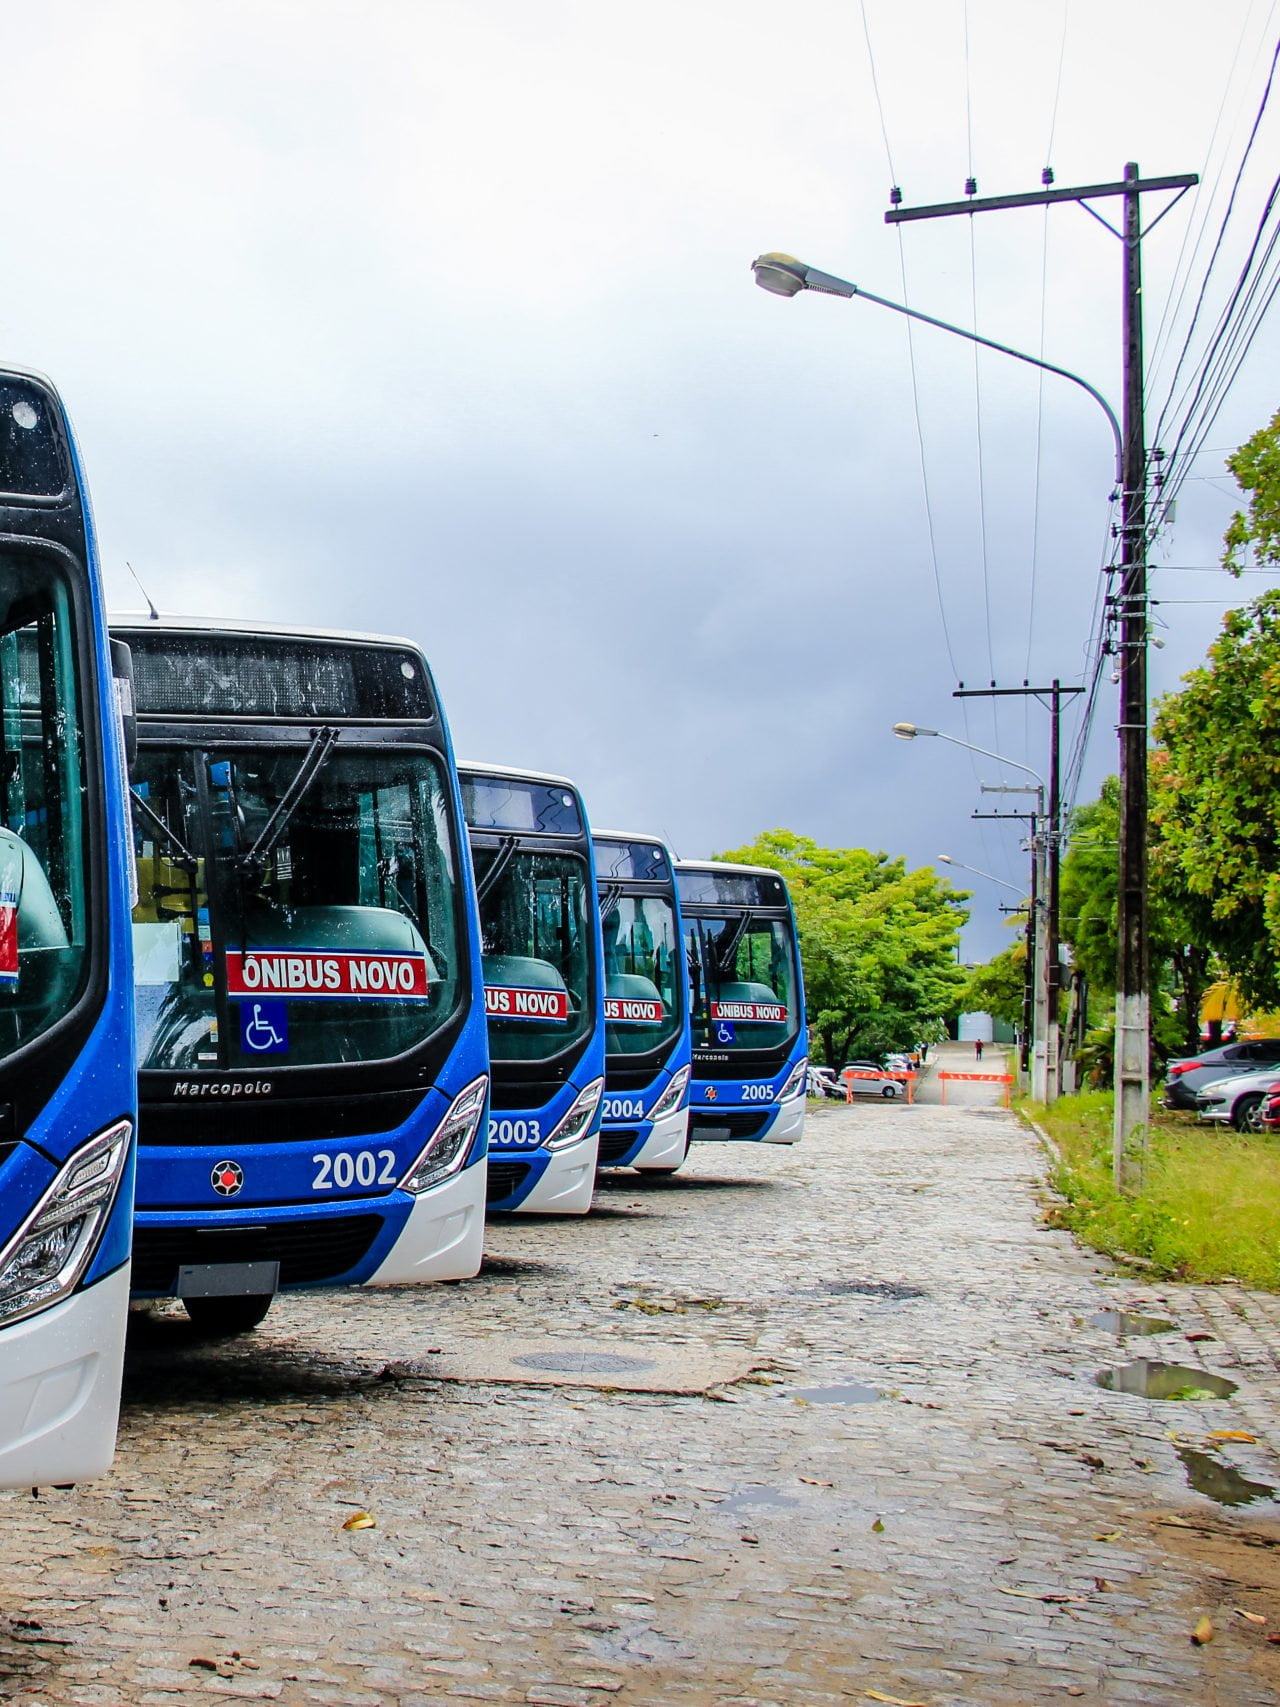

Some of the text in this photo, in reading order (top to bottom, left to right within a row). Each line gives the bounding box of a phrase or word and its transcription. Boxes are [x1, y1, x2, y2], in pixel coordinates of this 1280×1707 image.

[242, 955, 415, 991] ÔNIBUS NOVO
[516, 992, 559, 1015] NOVO
[623, 1002, 656, 1019] NOVO
[756, 1006, 780, 1020] NOVO
[173, 1081, 272, 1097] Marcopolo
[741, 1084, 774, 1100] 2005
[602, 1099, 644, 1118] 2004
[488, 1119, 540, 1144] 2003
[312, 1149, 397, 1190] 2002
